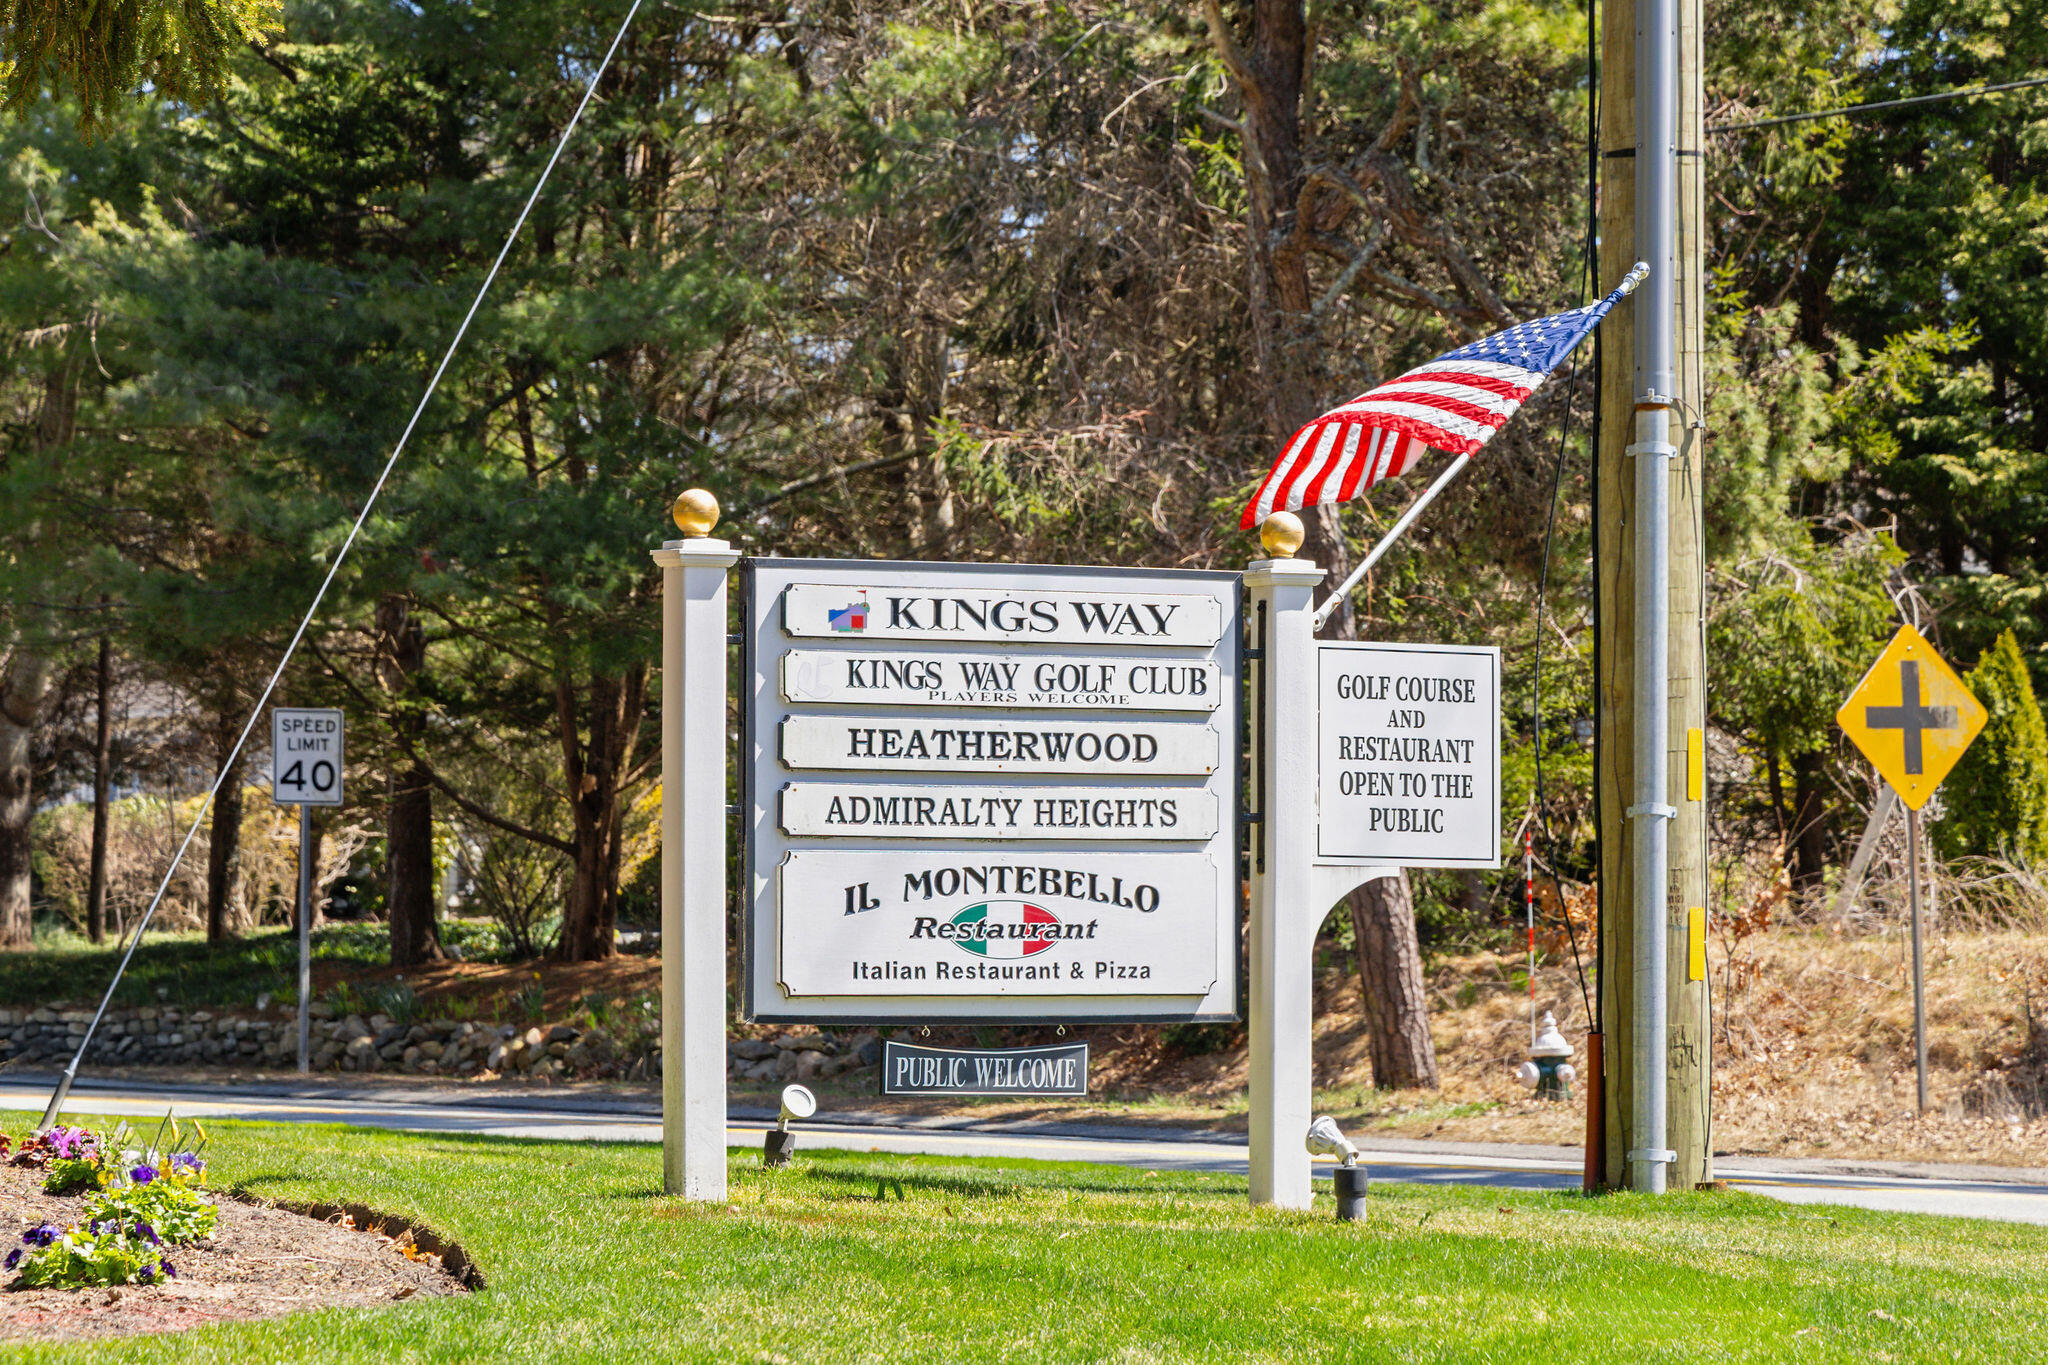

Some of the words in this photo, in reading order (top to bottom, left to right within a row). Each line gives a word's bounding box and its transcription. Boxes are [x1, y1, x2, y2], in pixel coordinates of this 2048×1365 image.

[885, 596, 1059, 634] KINGS
[1070, 601, 1181, 637] WAY
[846, 659, 943, 691] KINGS
[959, 662, 1021, 692] WAY
[1034, 664, 1117, 694] GOLF
[1129, 666, 1208, 696] CLUB
[1337, 674, 1391, 700] GOLF
[1395, 676, 1476, 703] COURSE
[928, 690, 1018, 703] PLAYERS
[1027, 693, 1130, 705] WELCOME
[282, 718, 336, 733] SPEED
[1387, 709, 1426, 729] AND
[288, 738, 329, 751] LIMIT
[847, 728, 1158, 762] HEATHERWOOD
[1338, 735, 1474, 764] RESTAURANT
[280, 760, 336, 792] 40
[1339, 770, 1395, 797] OPEN
[1399, 772, 1427, 798] TO
[1431, 773, 1473, 799] THE
[825, 795, 1022, 827] ADMIRALTY
[1033, 799, 1178, 828] HEIGHTS
[1369, 807, 1444, 834] PUBLIC
[843, 882, 880, 916] IL
[903, 866, 1160, 913] MONTEBELLO
[909, 916, 1099, 940] Restaurant
[852, 960, 926, 980] Italian
[935, 961, 1061, 980] Restaurant
[1069, 961, 1085, 979] &
[1094, 961, 1152, 980] Pizza
[894, 1056, 967, 1088] PUBLIC
[974, 1057, 1077, 1089] WELCOME
